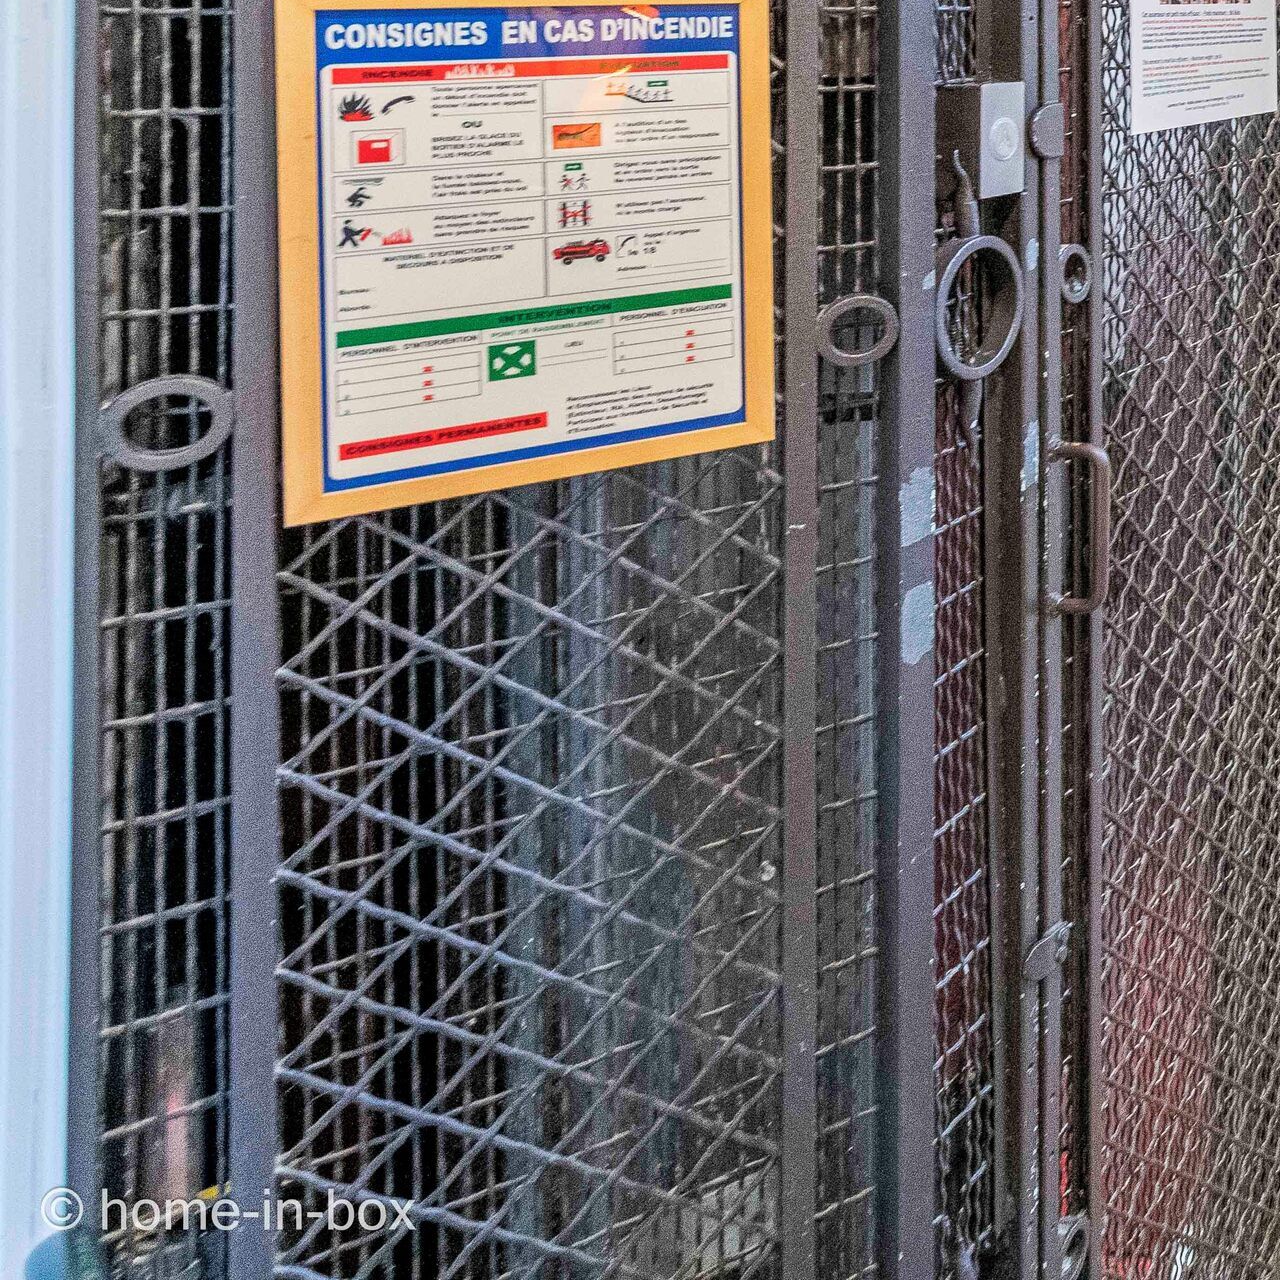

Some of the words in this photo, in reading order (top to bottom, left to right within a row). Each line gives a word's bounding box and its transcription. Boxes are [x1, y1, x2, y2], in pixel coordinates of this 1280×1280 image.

[324, 21, 488, 50] CONSIGNES
[501, 20, 538, 45] EN
[543, 18, 595, 44] CAS
[600, 16, 734, 42] D'INCENDIE
[361, 69, 433, 80] INCENDIE
[461, 120, 482, 128] OU
[498, 302, 612, 324] INTERVENTION
[345, 435, 433, 456] CONSIGNES
[438, 417, 542, 440] PERMANENTES
